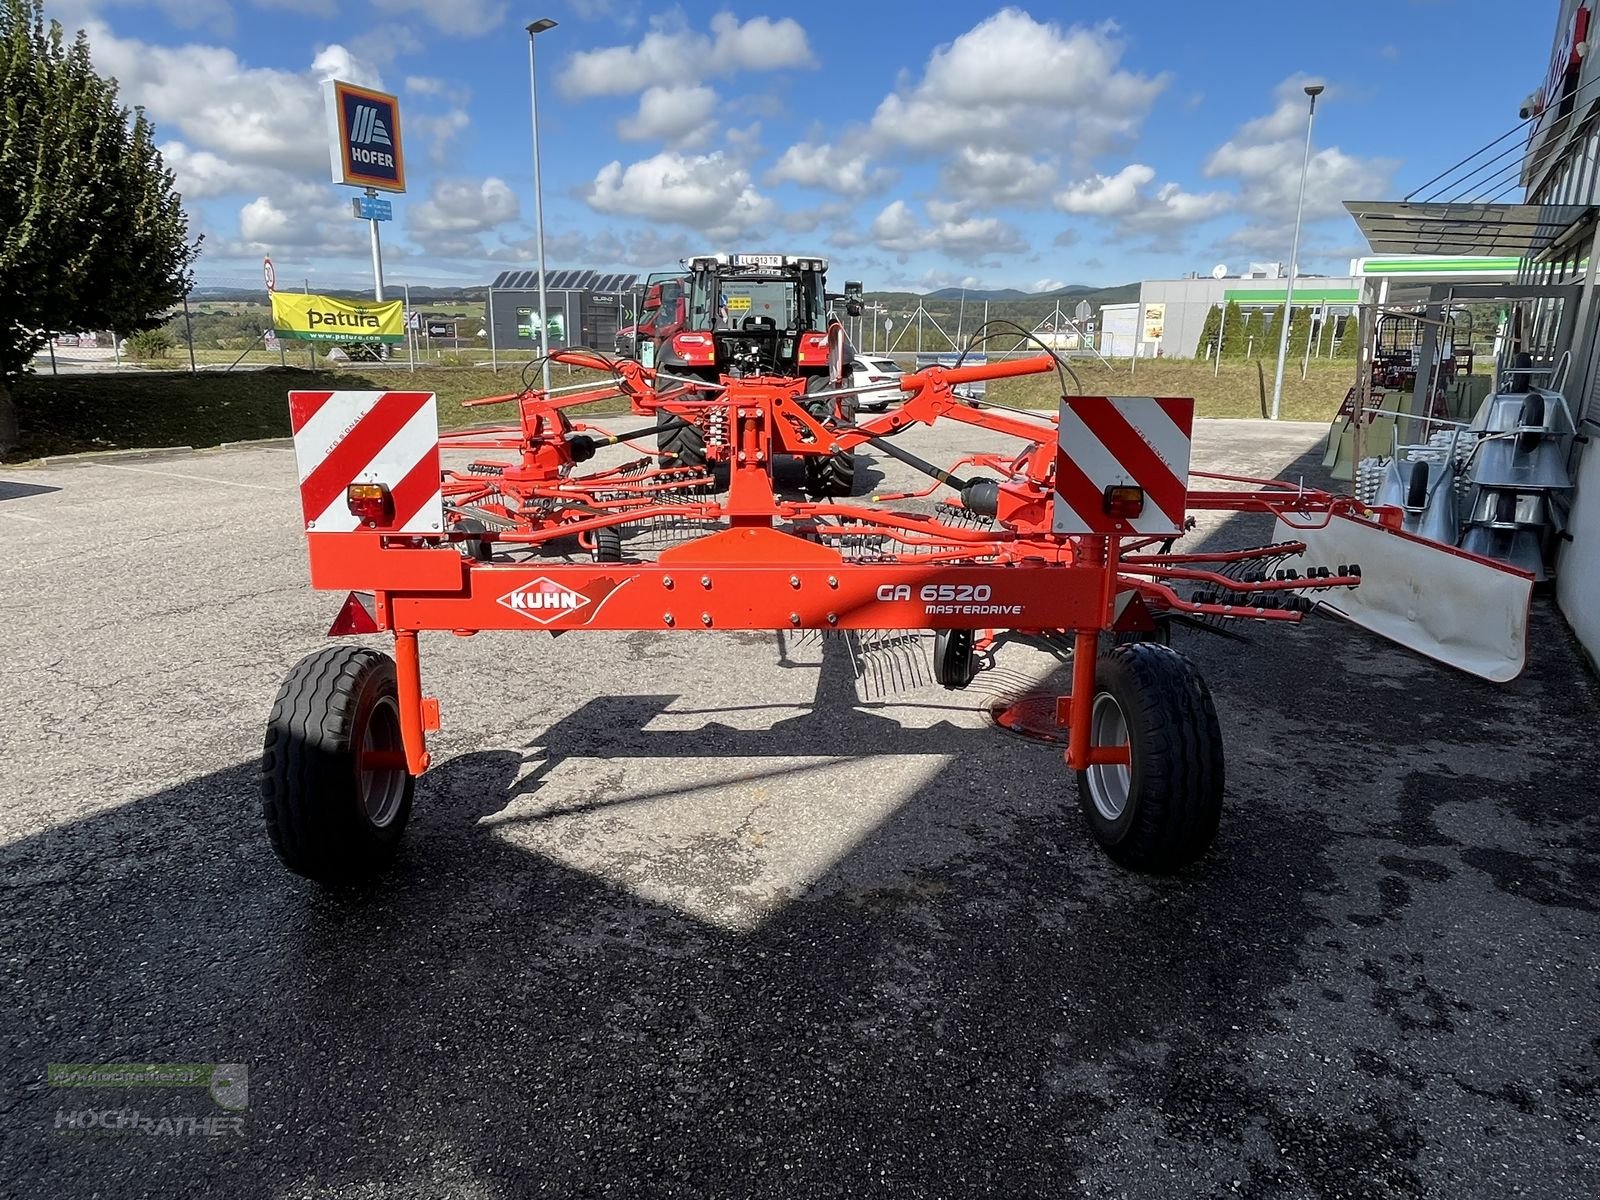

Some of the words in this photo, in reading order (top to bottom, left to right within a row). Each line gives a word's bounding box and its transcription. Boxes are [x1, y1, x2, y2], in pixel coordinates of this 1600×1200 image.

[352, 147, 394, 168] HOFER
[306, 308, 381, 329] patura
[309, 332, 381, 341] www.patura.com
[510, 592, 577, 609] KUHN
[876, 584, 911, 601] GA
[920, 584, 992, 602] 6520
[925, 605, 1022, 615] MASTERDRIVE
